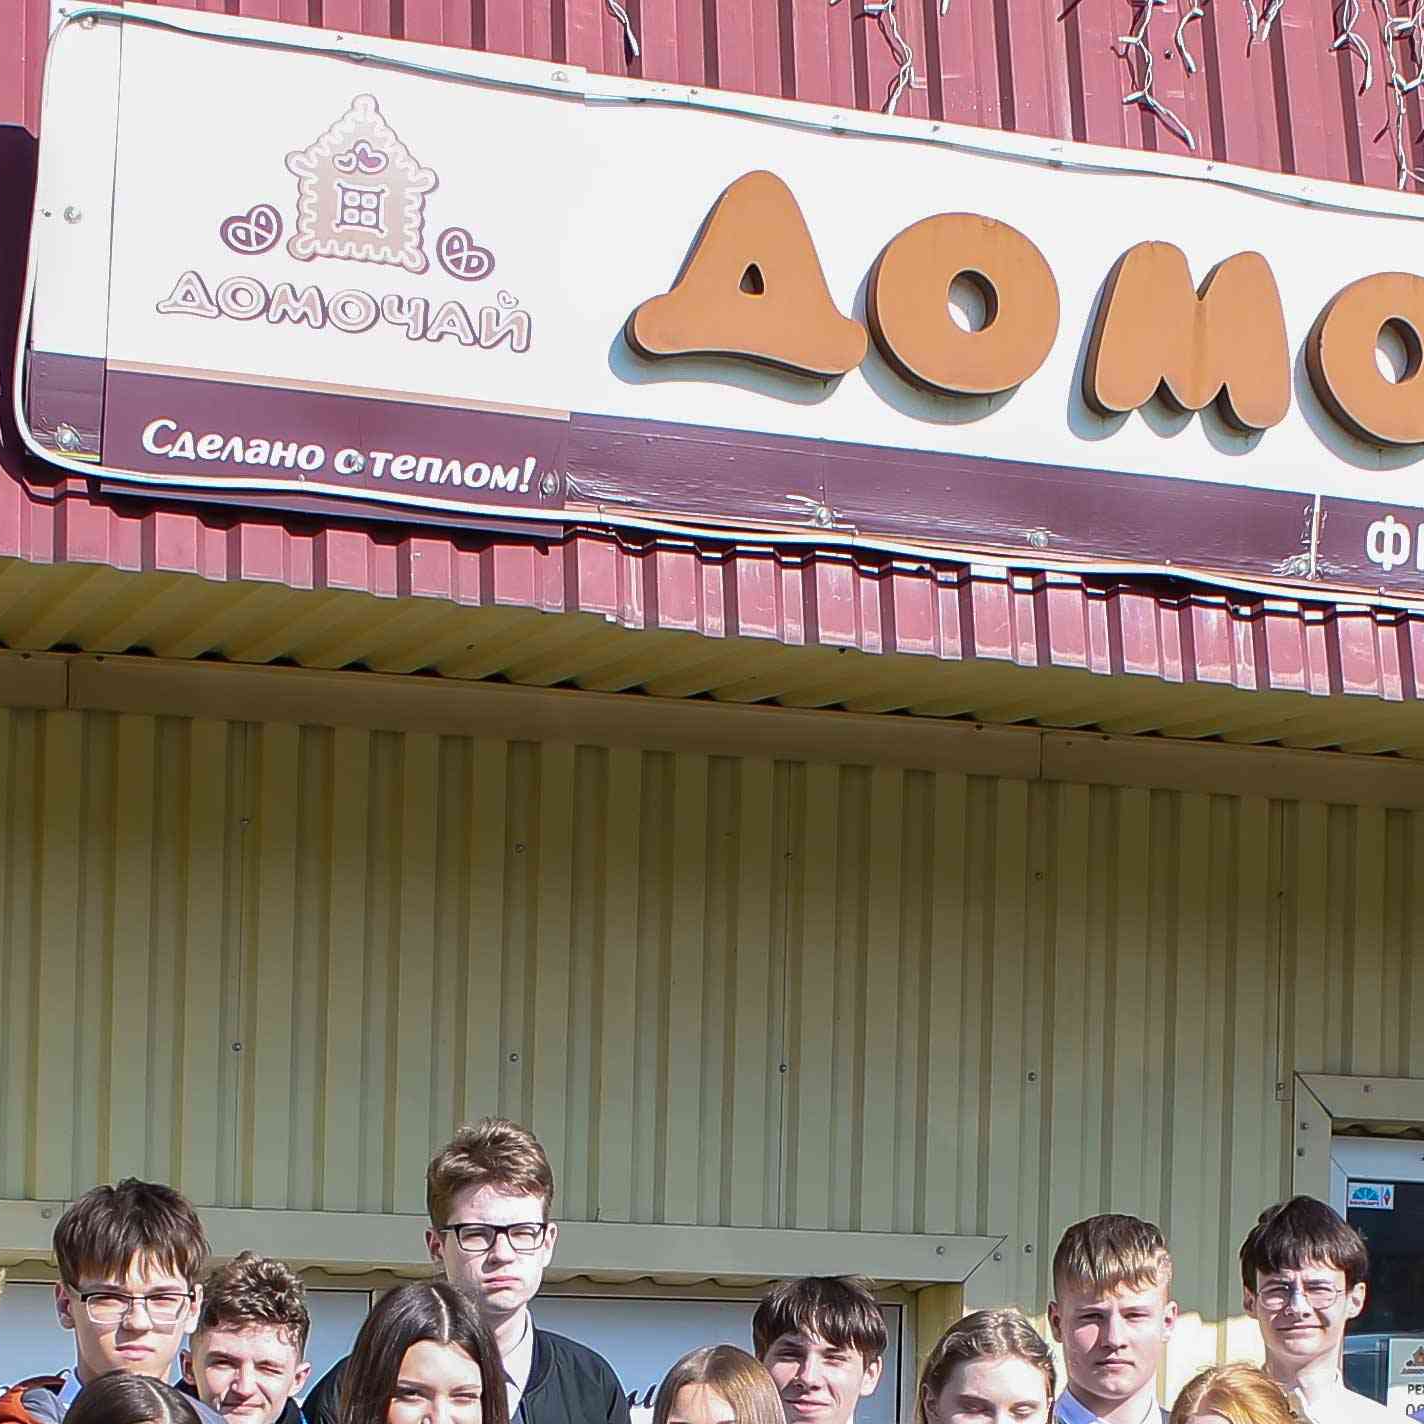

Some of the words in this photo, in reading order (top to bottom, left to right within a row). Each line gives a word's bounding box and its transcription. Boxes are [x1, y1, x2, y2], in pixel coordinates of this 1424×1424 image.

[156, 270, 531, 353] ДОМОЧАЙ
[141, 419, 324, 471] Сделано
[334, 453, 364, 475] с
[368, 455, 538, 496] теплом!
